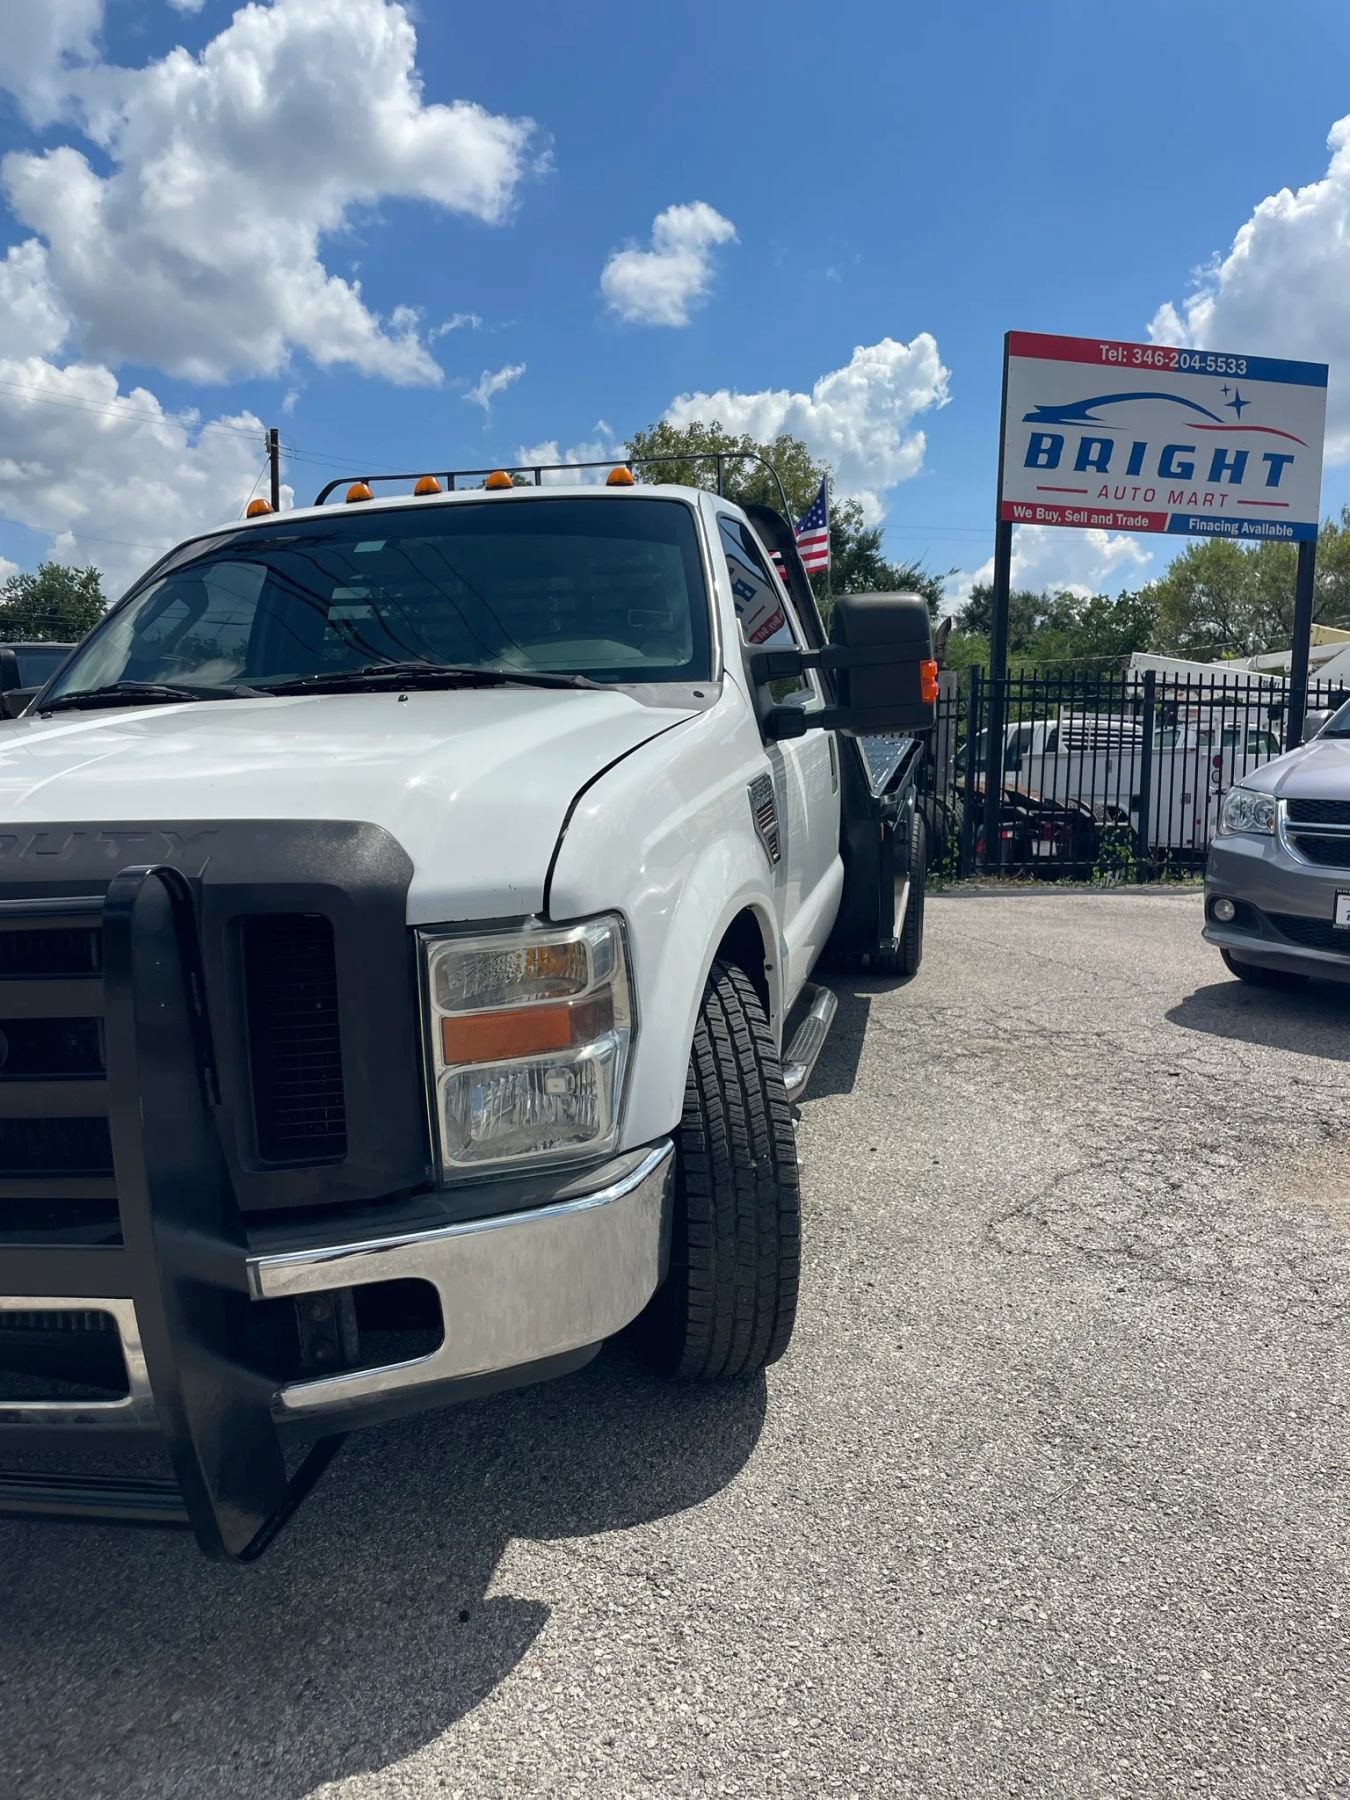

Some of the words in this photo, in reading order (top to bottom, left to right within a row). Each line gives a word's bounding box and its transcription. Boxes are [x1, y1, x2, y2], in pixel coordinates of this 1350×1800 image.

[1100, 345, 1127, 362] Tel:
[1132, 348, 1247, 375] 346-204-5533
[1023, 432, 1295, 488] BRIGHT
[1097, 484, 1156, 502] AUTO
[1167, 490, 1229, 508] MART
[1013, 505, 1033, 518] We
[1036, 507, 1061, 523] Buy,
[1065, 510, 1088, 523] Sell
[1091, 512, 1113, 525] and
[1116, 514, 1149, 527] Trade
[1189, 518, 1239, 535] Finacing
[1241, 521, 1294, 537] Available
